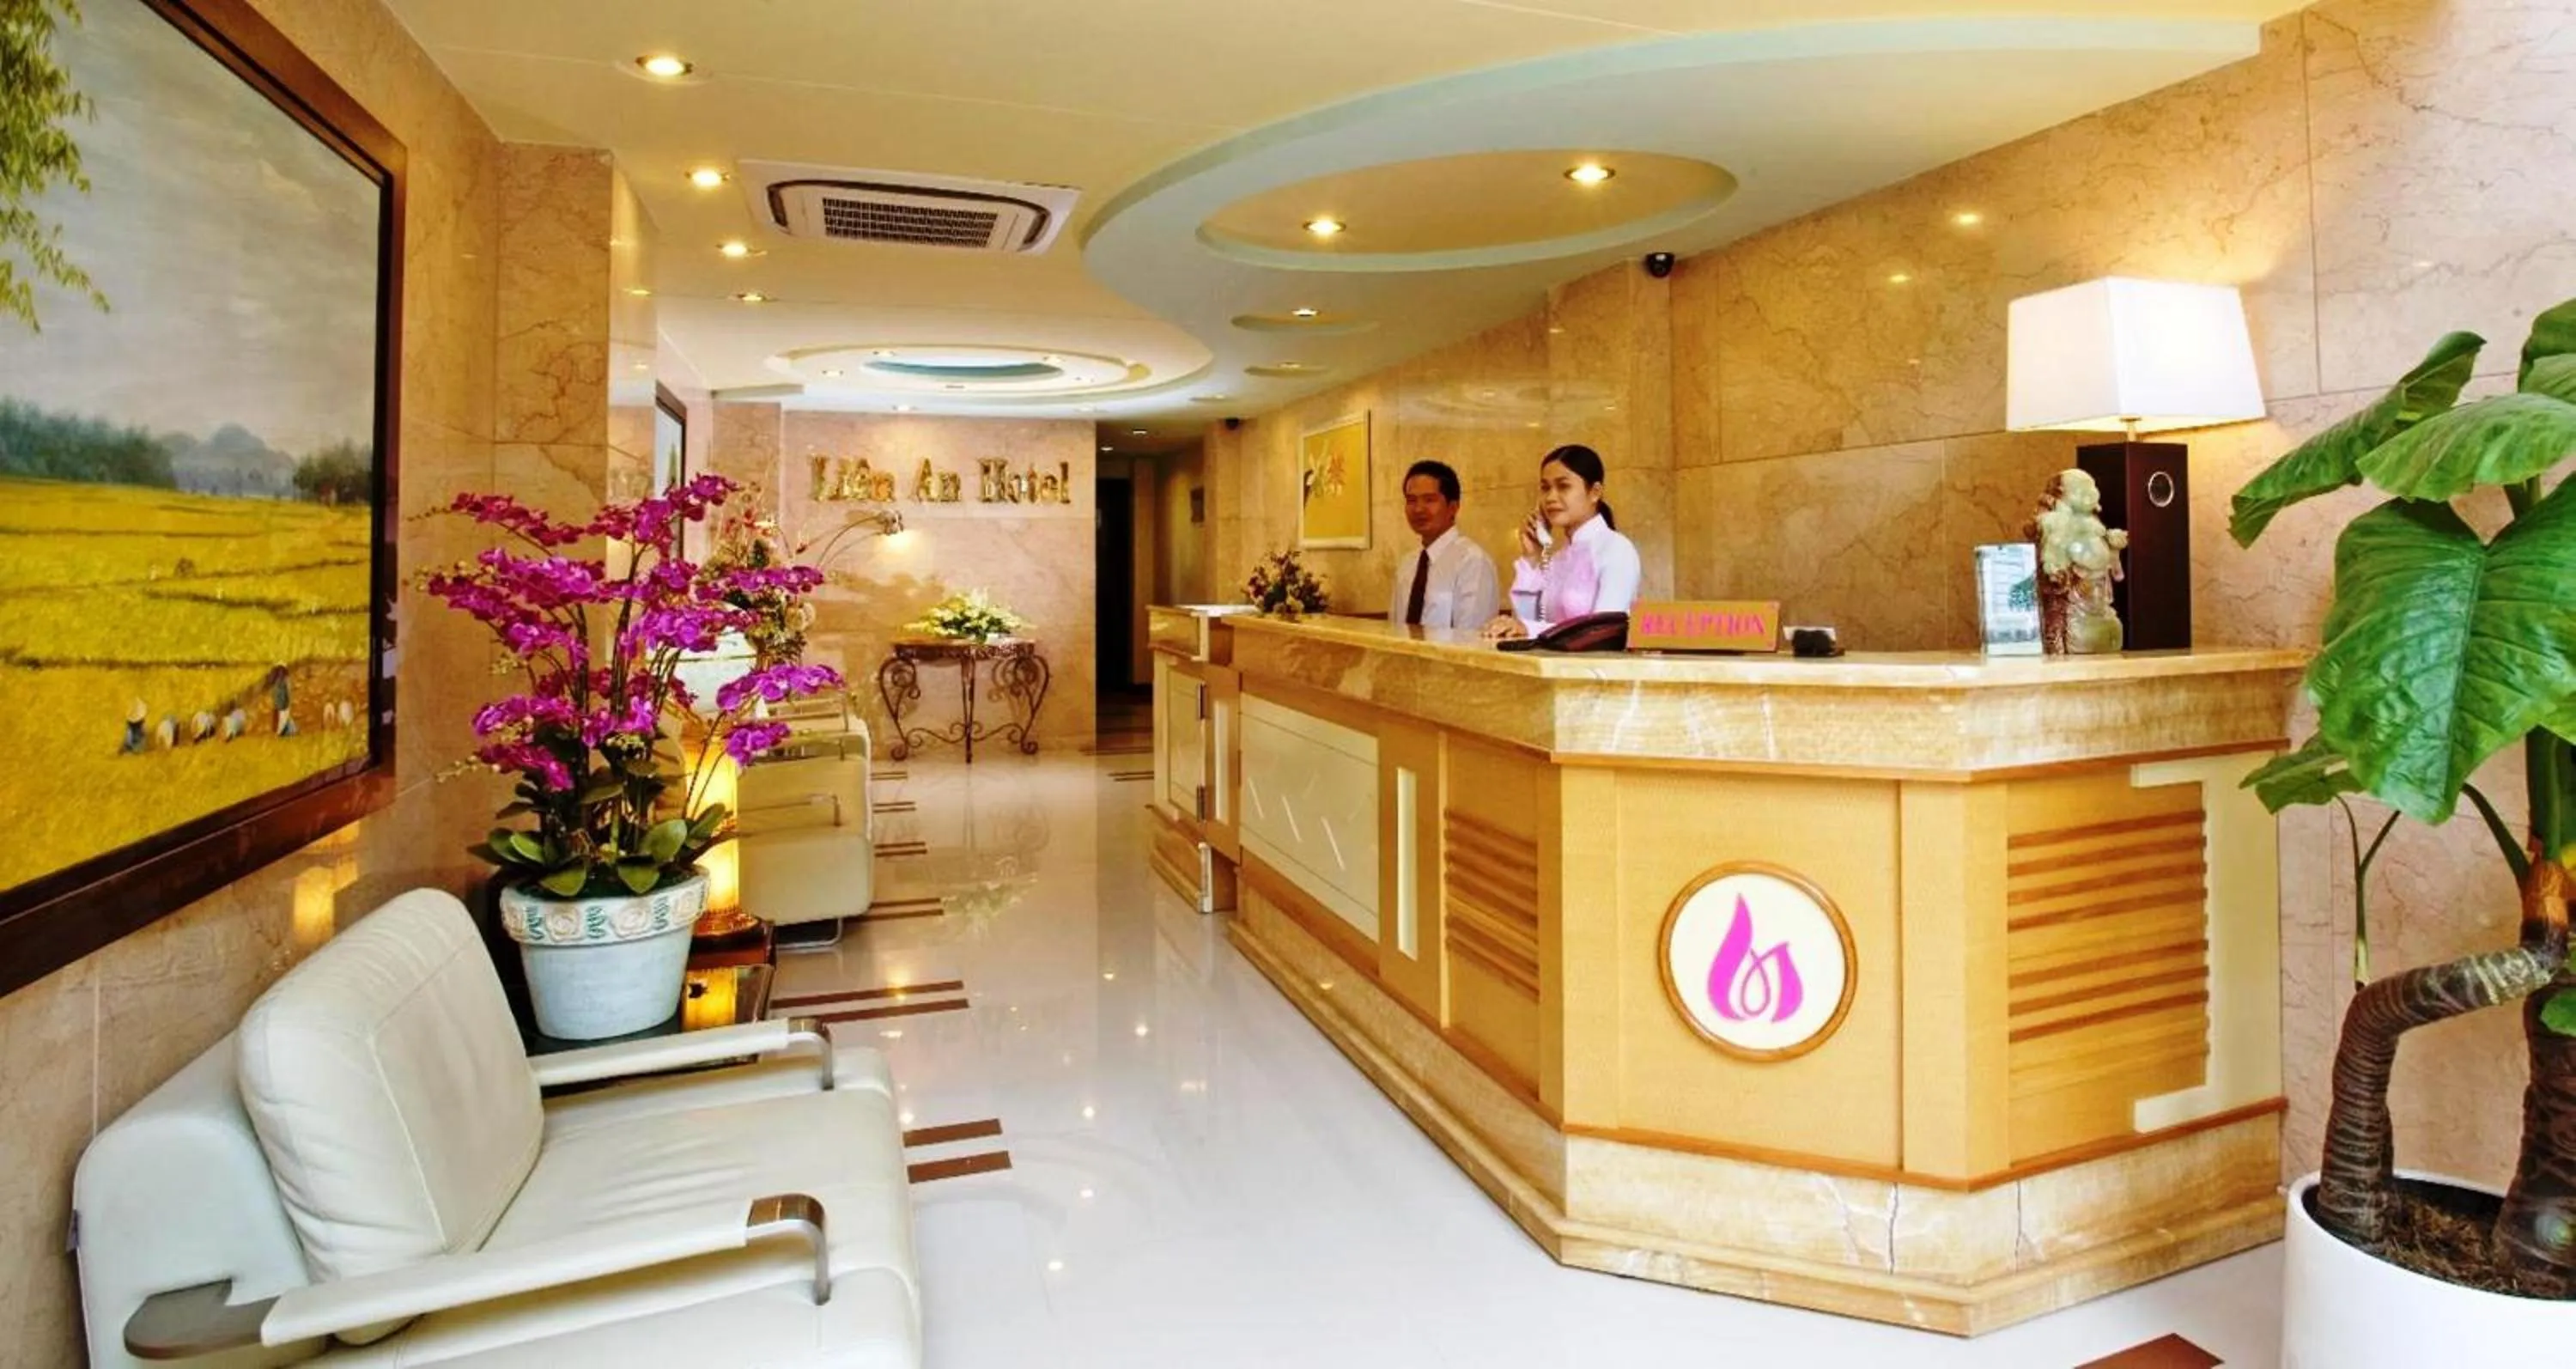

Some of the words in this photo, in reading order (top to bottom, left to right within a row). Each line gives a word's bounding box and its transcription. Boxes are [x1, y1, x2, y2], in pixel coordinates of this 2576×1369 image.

[910, 458, 961, 502] An
[977, 457, 1071, 503] Hotel
[1641, 611, 1765, 637] RECEPTION
